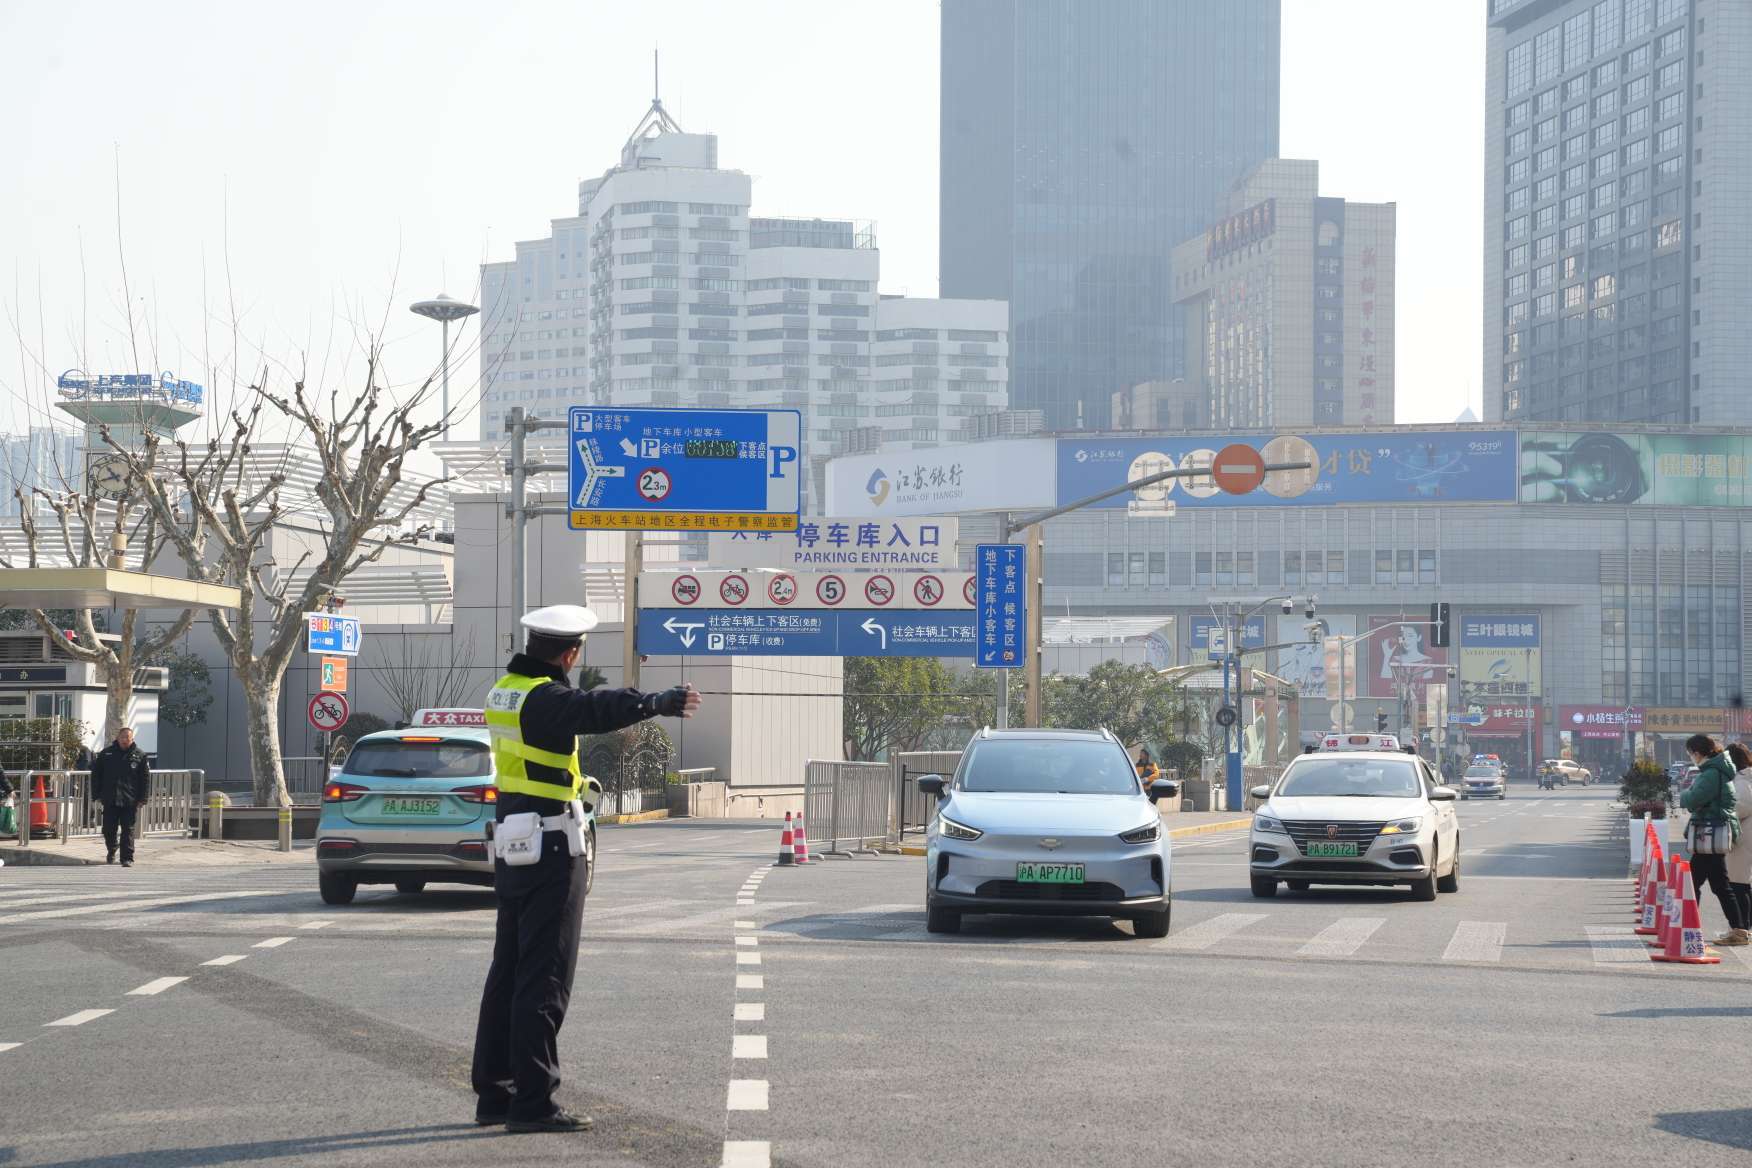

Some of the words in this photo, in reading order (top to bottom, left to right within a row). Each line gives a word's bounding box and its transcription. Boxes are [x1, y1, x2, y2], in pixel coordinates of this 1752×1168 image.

[576, 413, 591, 431] P
[642, 427, 724, 437] 地下车库小型客车
[643, 439, 658, 457] P
[660, 442, 685, 455] 余位
[769, 446, 797, 478] P
[896, 463, 964, 491] 江苏银行
[796, 522, 940, 548] 停车库入口
[794, 552, 861, 563] PARKING
[861, 551, 939, 563] ENTRANCE
[825, 581, 838, 599] 5
[984, 548, 998, 646] 地下车库小客车
[711, 635, 721, 648] P
[427, 712, 457, 724] 大众
[460, 713, 484, 723] TAXI
